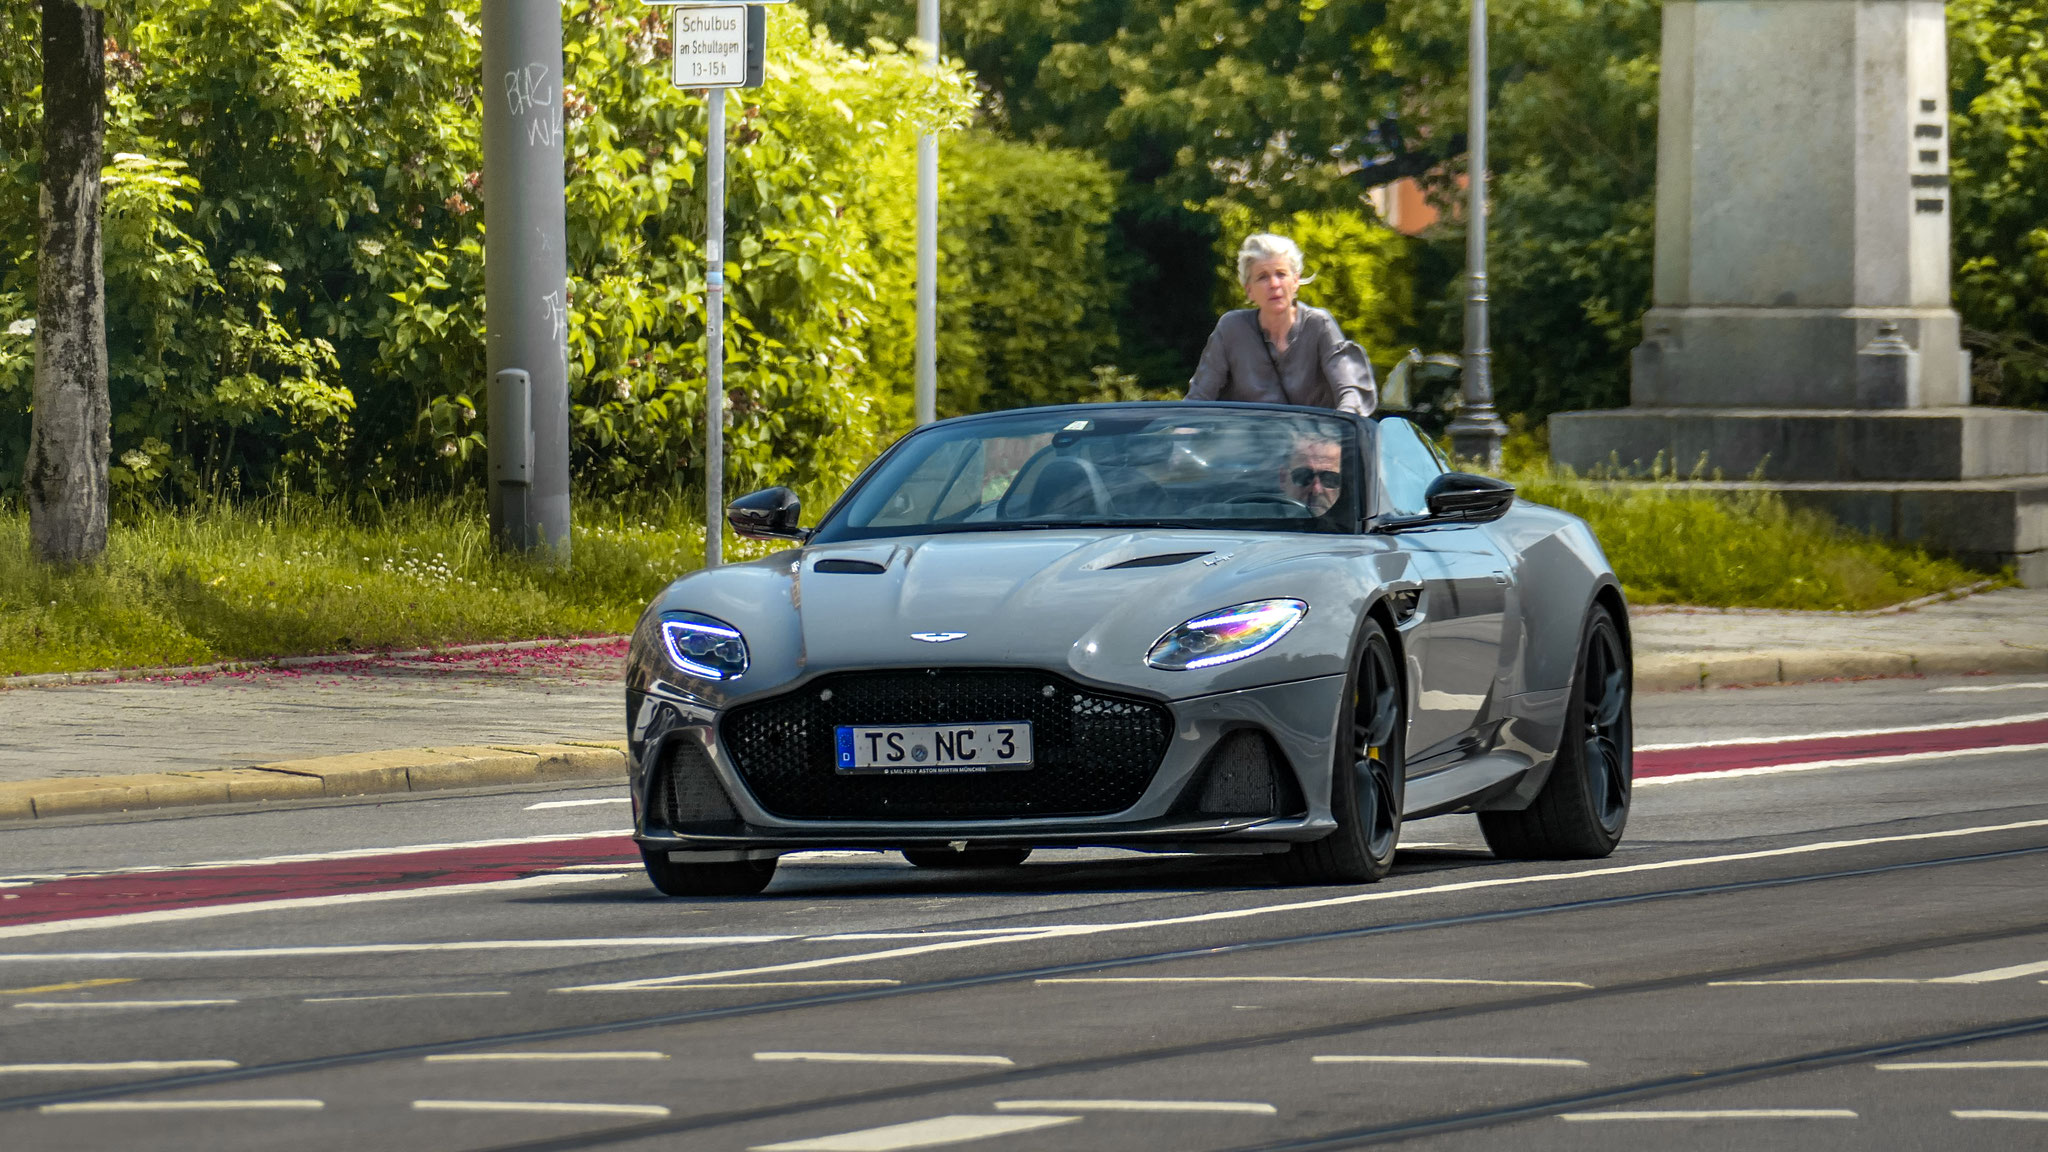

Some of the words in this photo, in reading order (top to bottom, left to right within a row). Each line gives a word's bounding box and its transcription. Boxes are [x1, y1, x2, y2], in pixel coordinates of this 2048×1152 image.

[682, 16, 737, 32] Schulbus
[680, 44, 690, 55] an
[692, 40, 739, 57] Schultagen
[692, 62, 719, 76] 13-15
[864, 732, 906, 762] TS
[935, 729, 977, 761] NC
[997, 728, 1015, 759] 3
[842, 752, 851, 761] D
